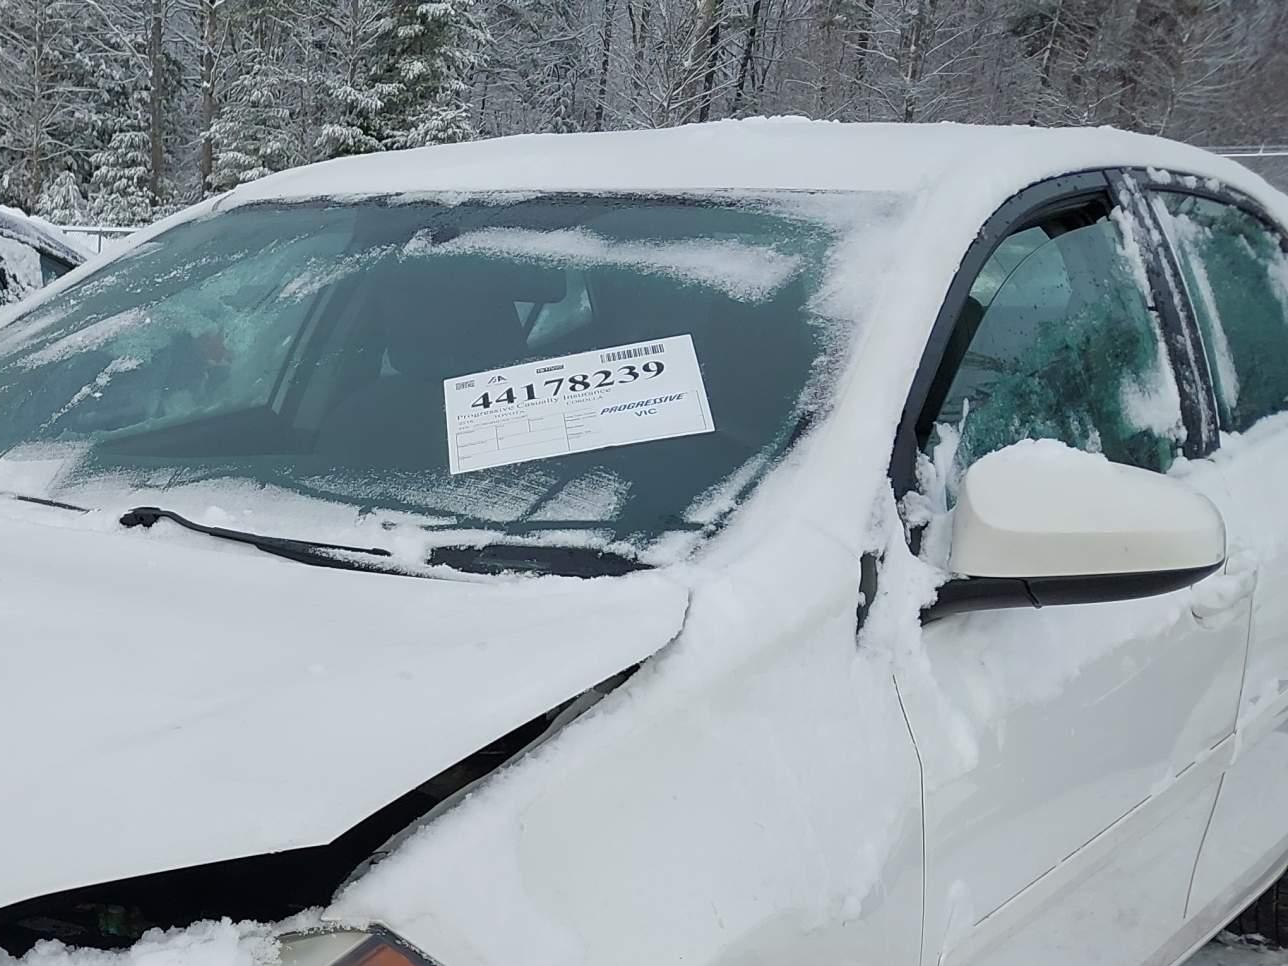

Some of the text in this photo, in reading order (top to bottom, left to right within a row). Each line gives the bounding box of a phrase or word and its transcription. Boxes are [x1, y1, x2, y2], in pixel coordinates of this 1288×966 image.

[471, 361, 665, 409] 44178239
[457, 386, 612, 420] Progressive Casualty Insurance
[565, 394, 604, 405] COROLLA
[600, 393, 686, 416] PROGRESSIVE
[494, 410, 527, 419] TOYOTA
[634, 408, 658, 417] VIC
